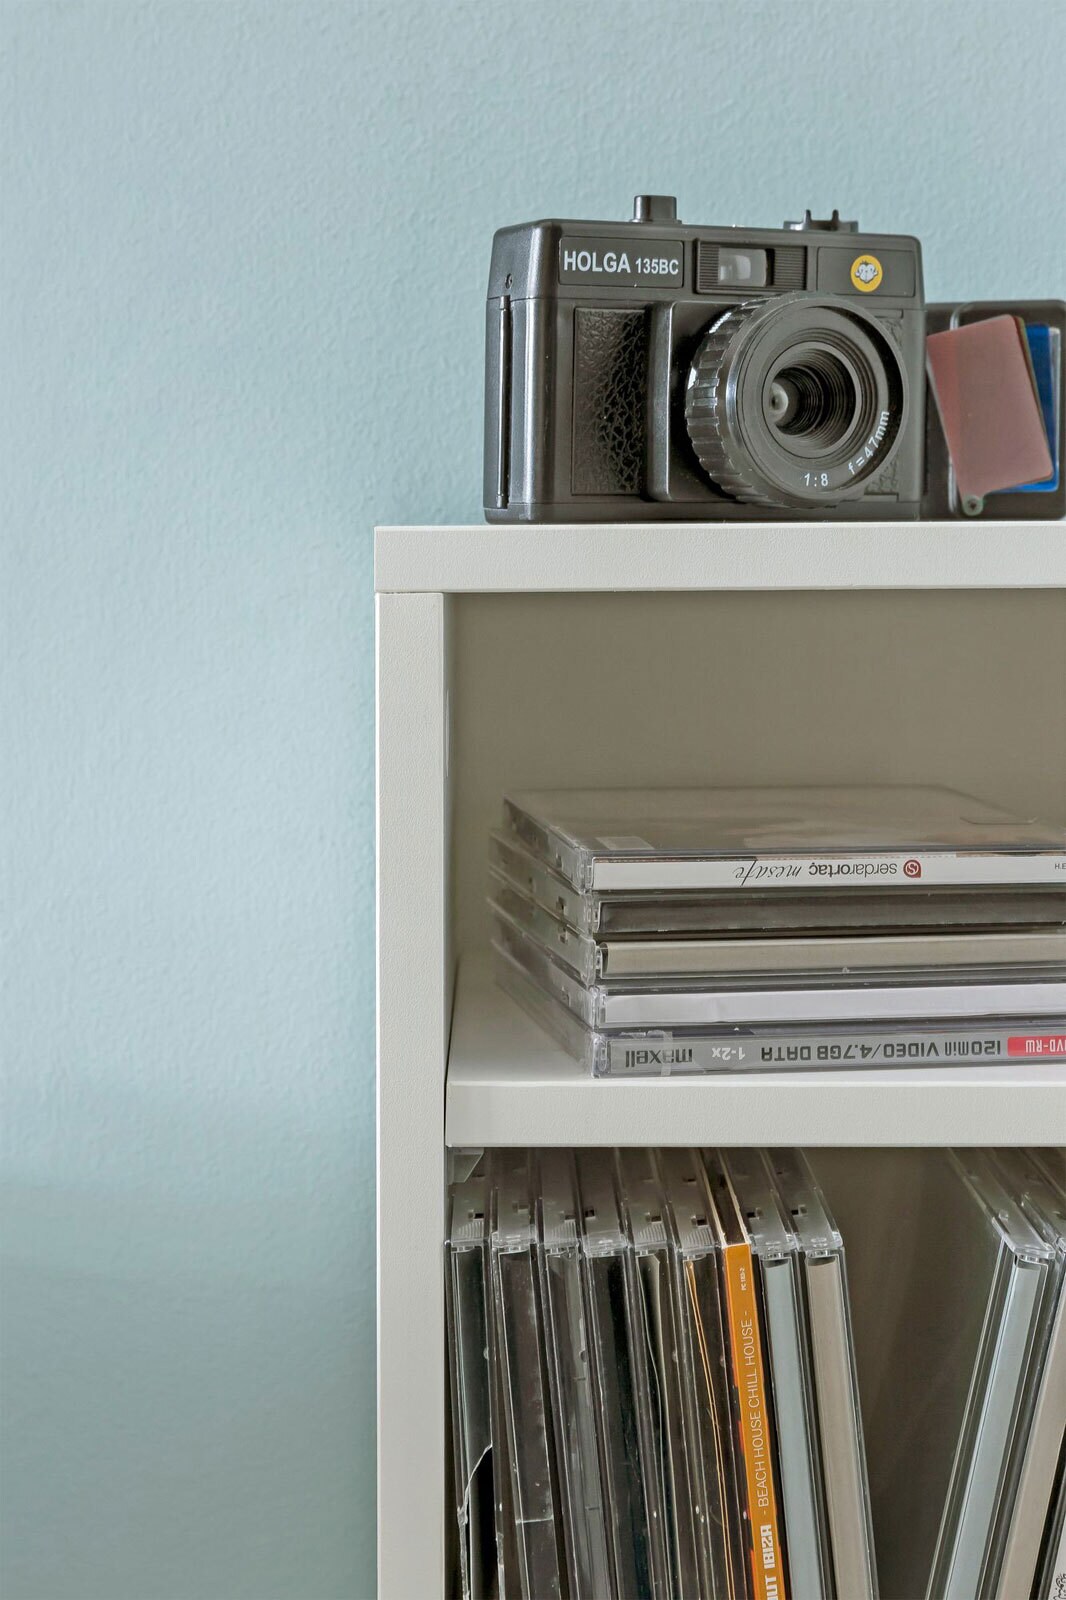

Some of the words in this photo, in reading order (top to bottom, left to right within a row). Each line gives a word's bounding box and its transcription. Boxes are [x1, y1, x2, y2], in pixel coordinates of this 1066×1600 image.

[563, 250, 631, 273] HOLGA
[635, 258, 679, 275] 135BC
[804, 473, 829, 486] 1:8
[733, 860, 802, 887] mesafe
[808, 862, 898, 878] serdarortaç
[625, 1048, 693, 1068] maxell
[711, 1047, 746, 1061] 1-2x
[761, 1045, 812, 1062] DATA
[741, 1319, 756, 1366] HOUSE
[745, 1368, 760, 1408] CHILL
[750, 1410, 765, 1458] HOUSE
[755, 1461, 769, 1507] BEACH
[760, 1524, 776, 1569] IBIZA
